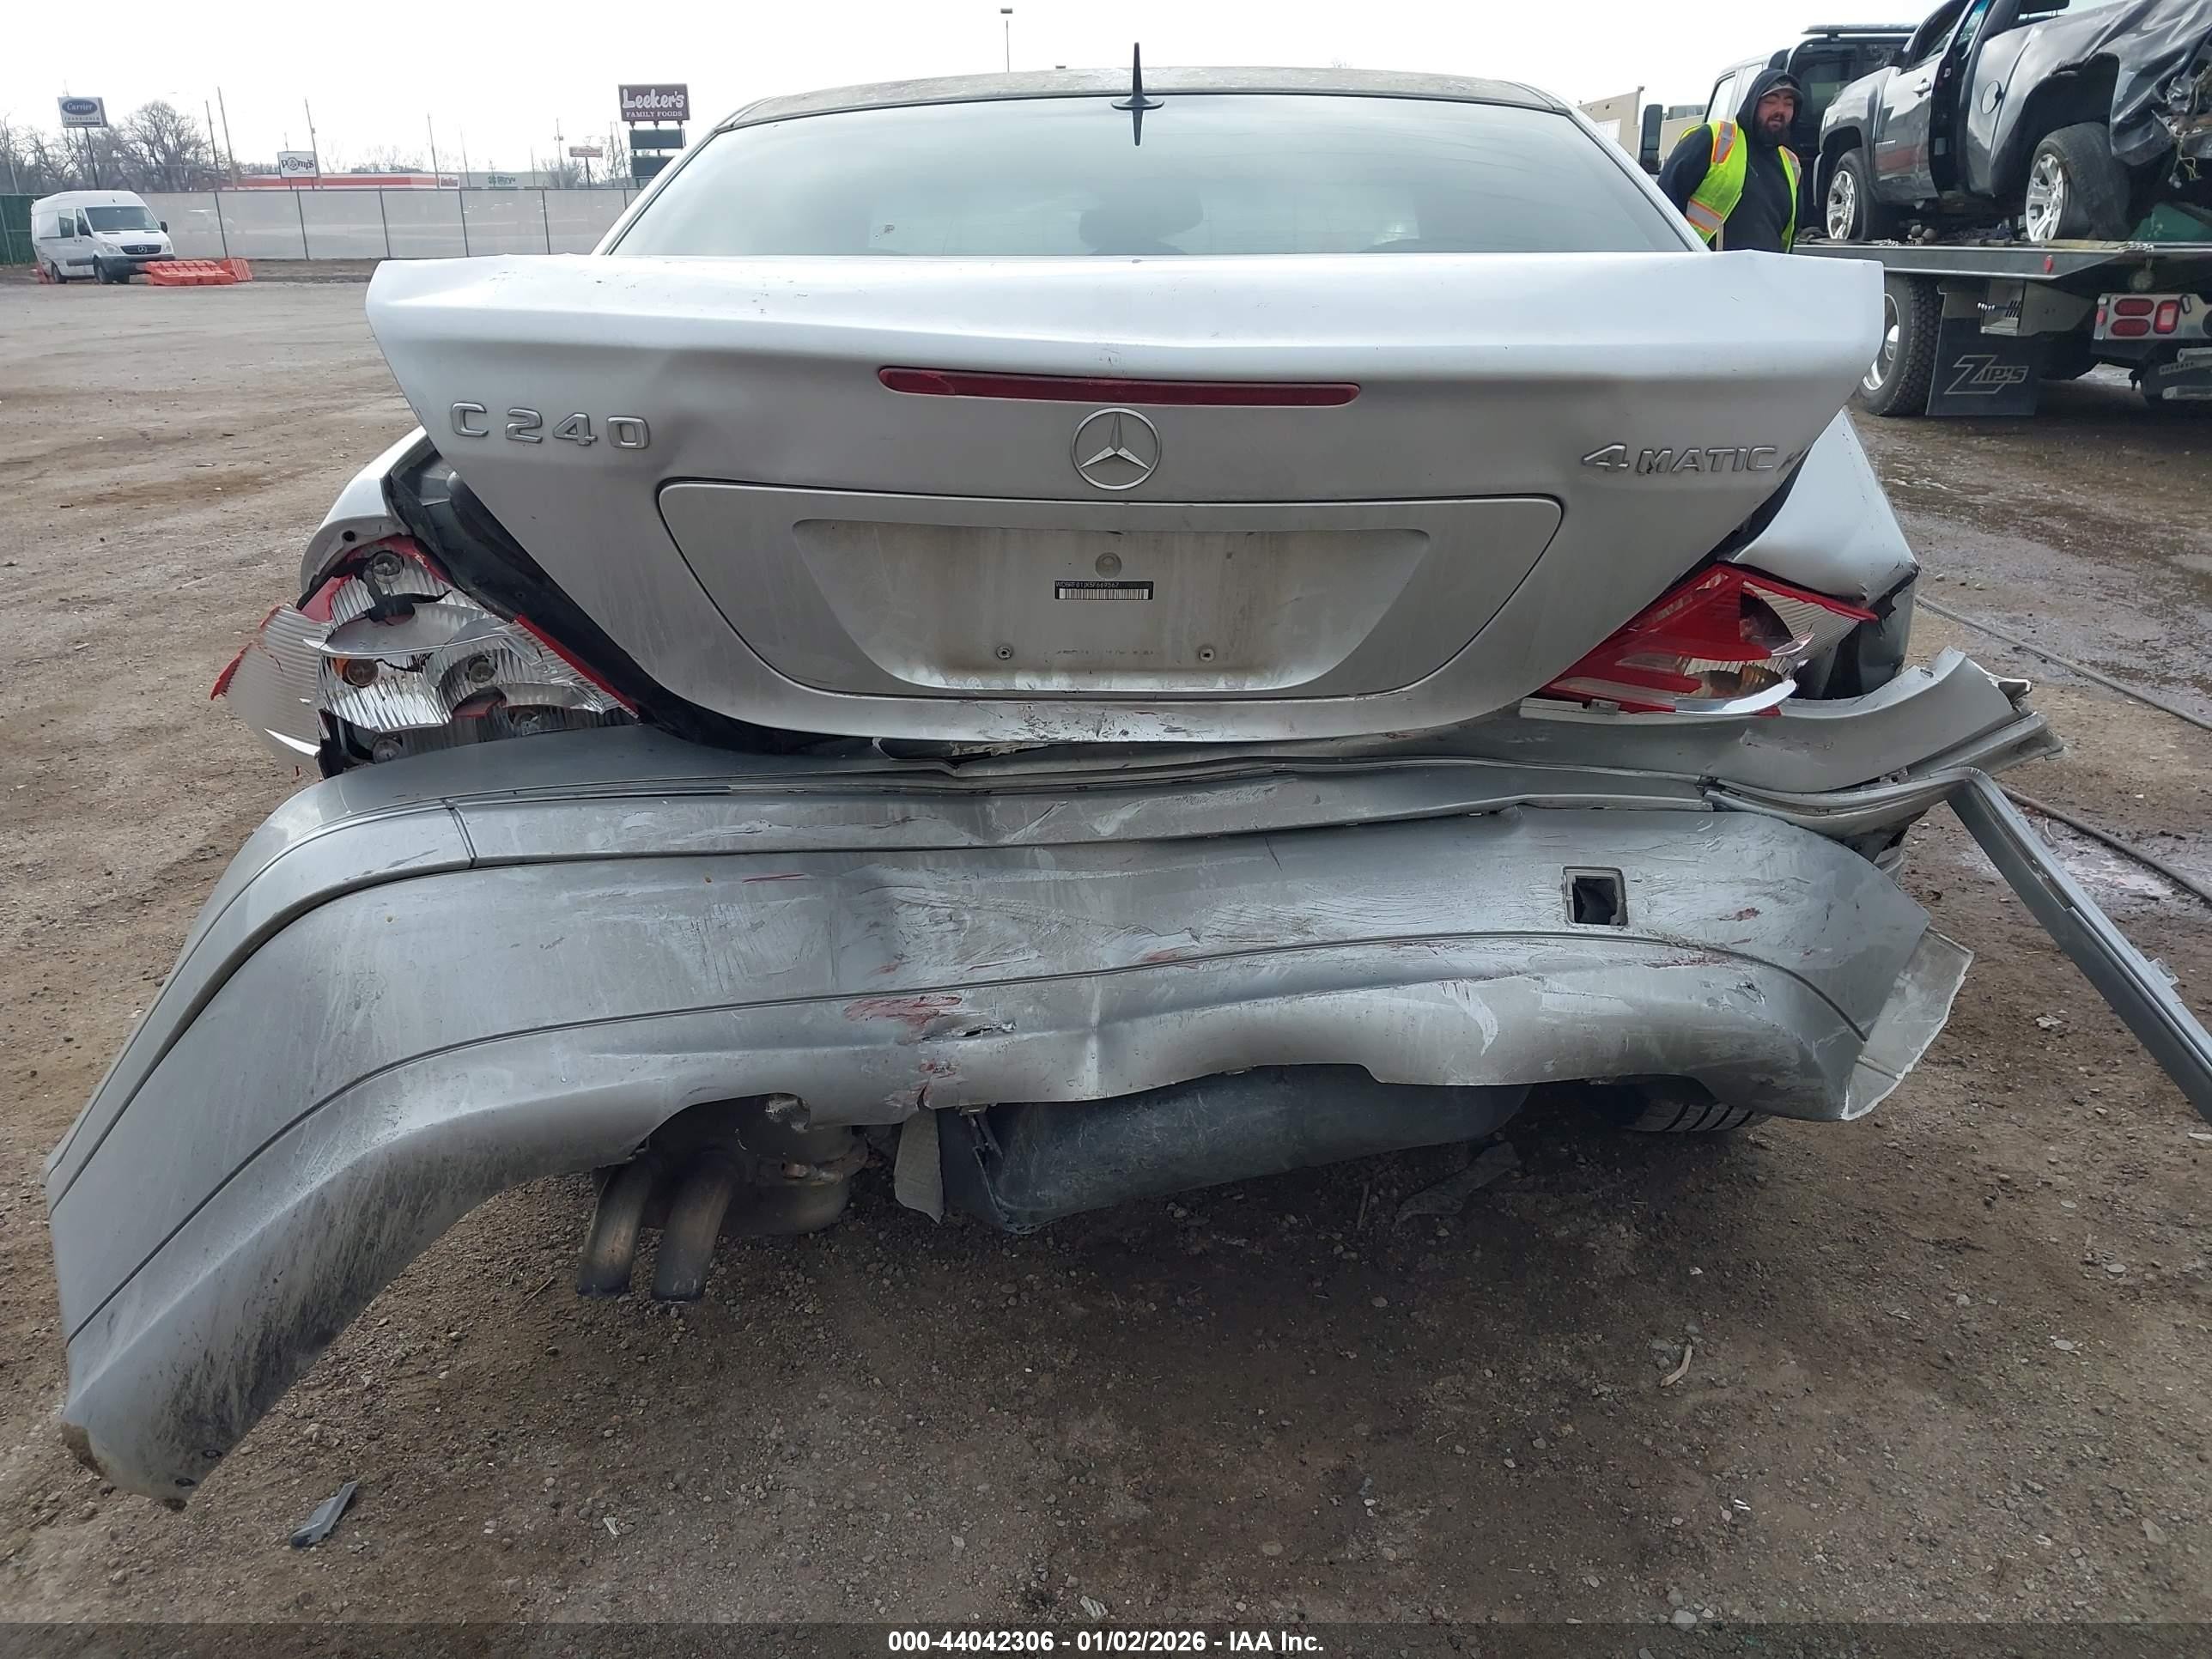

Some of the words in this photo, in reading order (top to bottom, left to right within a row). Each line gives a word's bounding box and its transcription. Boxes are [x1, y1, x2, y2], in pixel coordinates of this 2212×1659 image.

[67, 102, 93, 111] Carrier
[622, 88, 685, 109] Leeker's
[451, 401, 489, 437] C
[505, 407, 650, 449] 240
